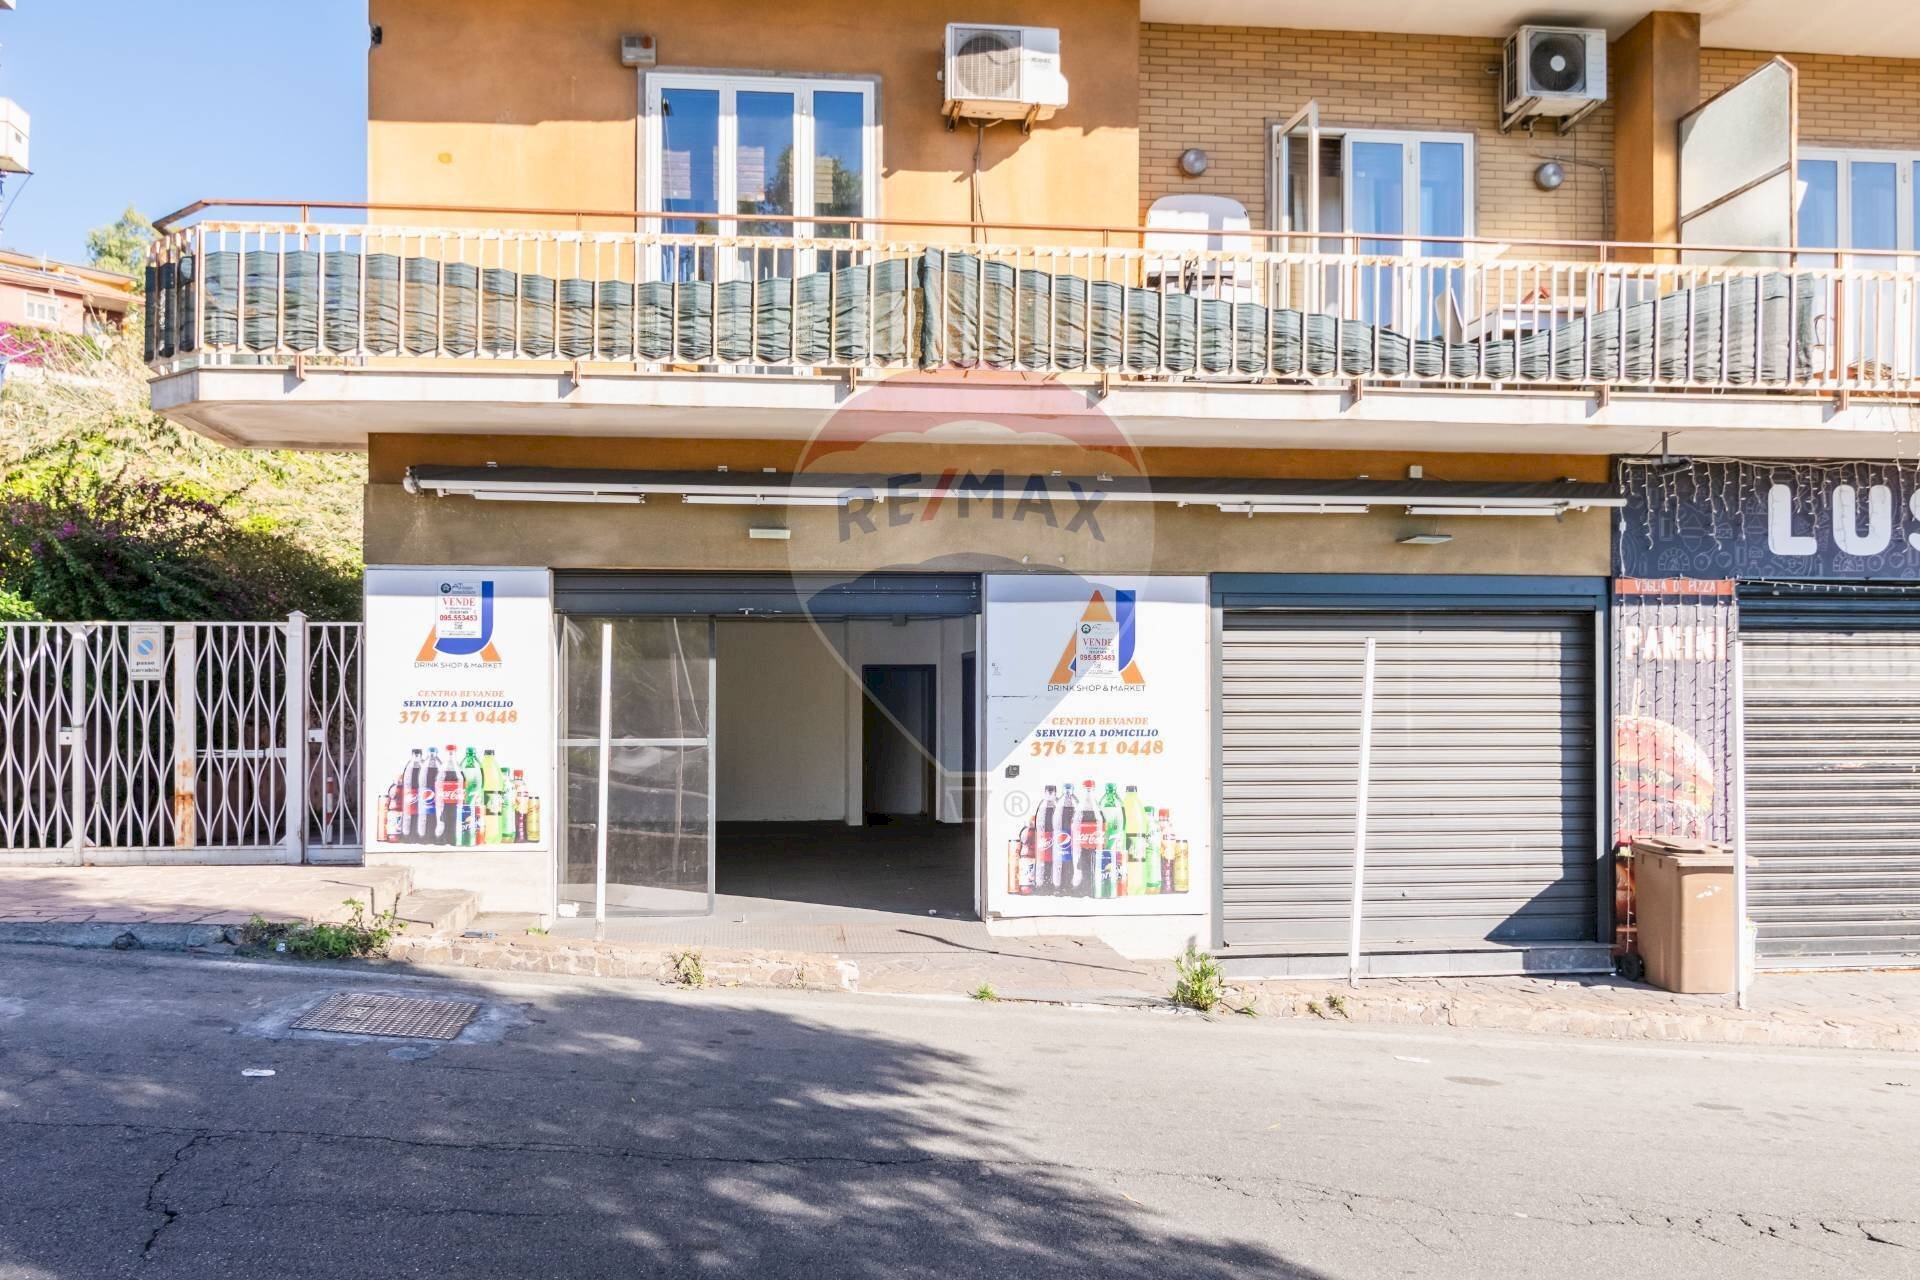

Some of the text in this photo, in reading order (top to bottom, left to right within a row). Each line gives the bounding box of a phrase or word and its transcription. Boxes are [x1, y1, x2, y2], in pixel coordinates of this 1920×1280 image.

[1768, 484, 1920, 556] LU
[442, 597, 476, 606] VENDE
[1083, 638, 1113, 647] VENDE
[1624, 626, 1728, 660] PANINI
[402, 700, 514, 708] SERVIZIO A DOMICILIO
[398, 710, 518, 724] 376 211 0448
[1051, 717, 1149, 725] CENTRO BEVANDE
[1035, 729, 1159, 737] SERVIZIO A DOMICILIO
[1030, 740, 1164, 757] 376 211 0448
